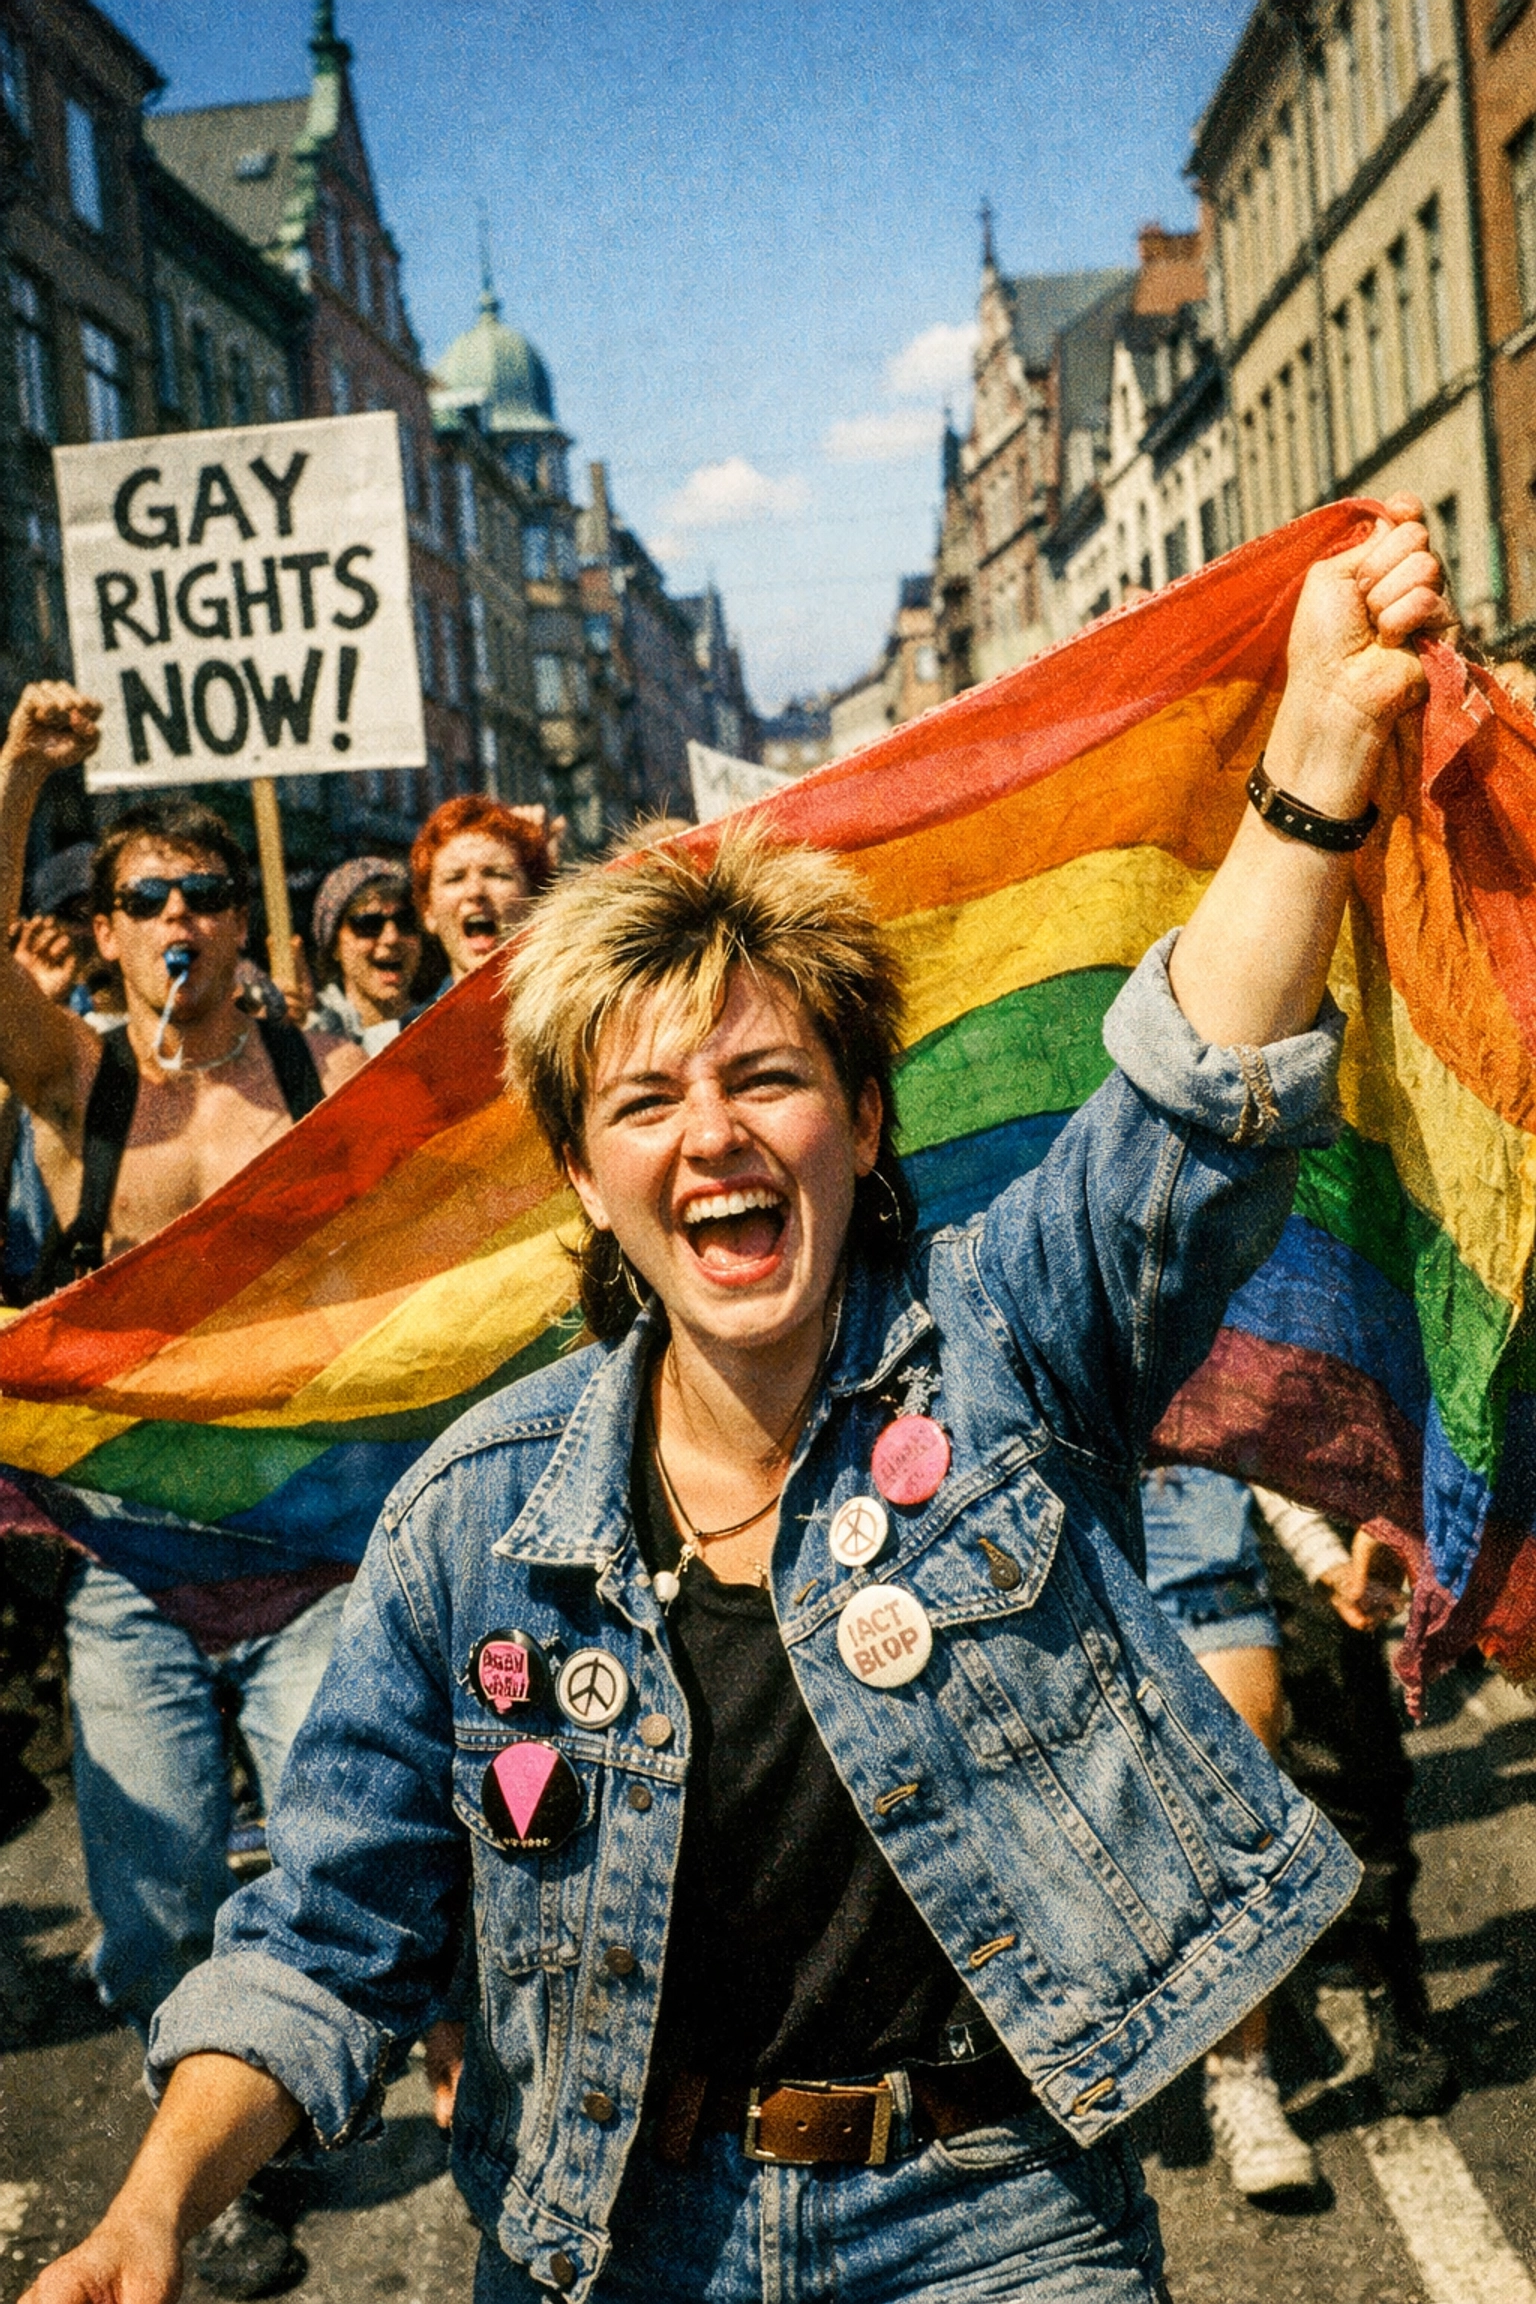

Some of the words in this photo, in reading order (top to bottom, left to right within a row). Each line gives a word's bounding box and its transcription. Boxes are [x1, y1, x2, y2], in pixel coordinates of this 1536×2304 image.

[114, 451, 308, 550] GAY
[95, 545, 379, 651] RIGHTS
[120, 646, 358, 765] NOW!
